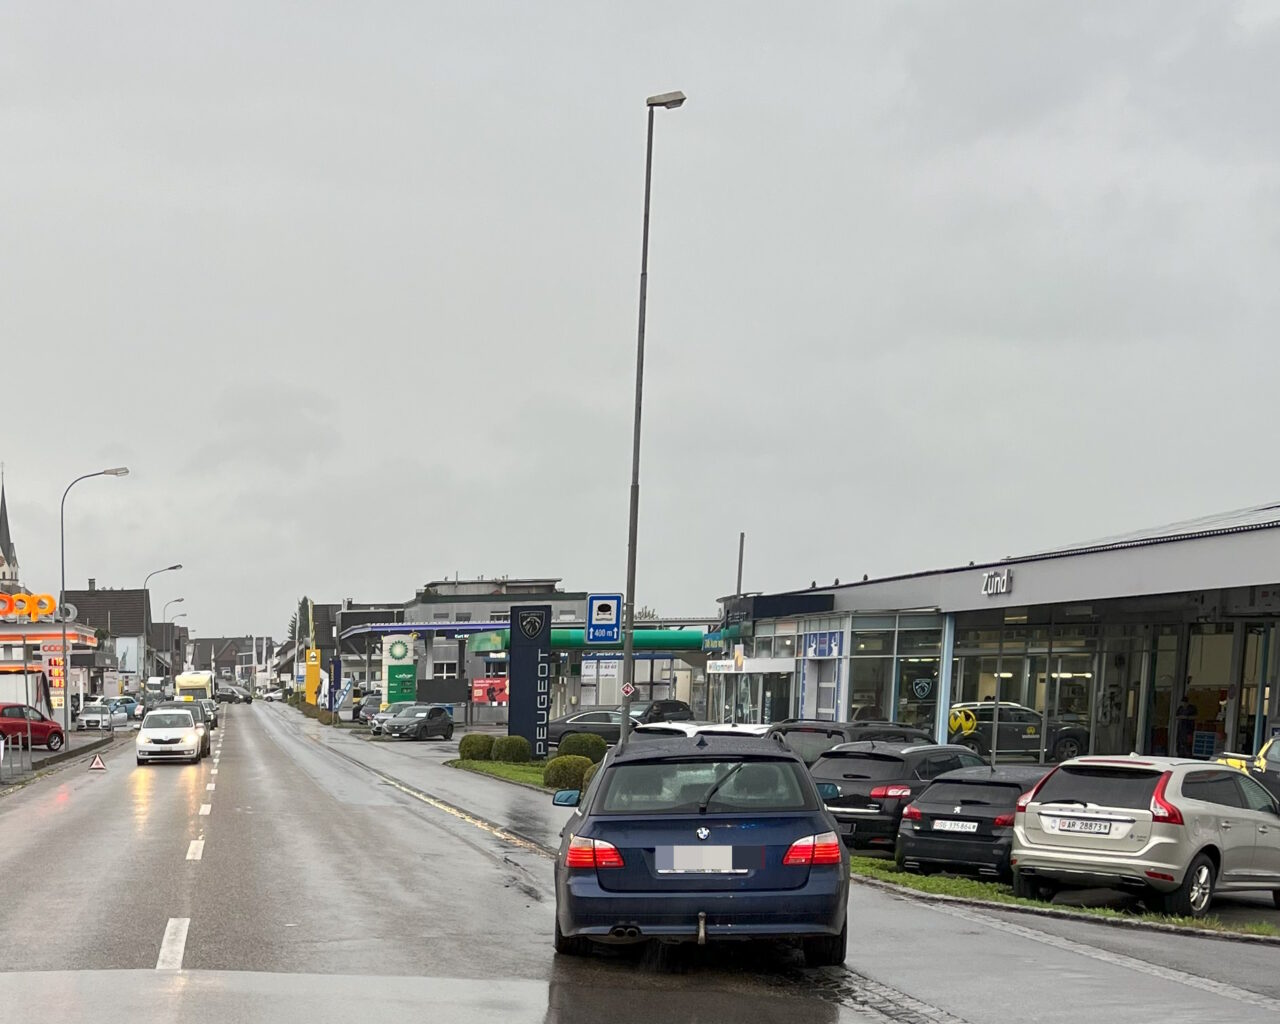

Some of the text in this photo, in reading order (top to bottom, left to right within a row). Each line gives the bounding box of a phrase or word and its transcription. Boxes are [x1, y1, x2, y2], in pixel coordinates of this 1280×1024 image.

[981, 568, 1008, 595] Zünd
[594, 628, 613, 638] 400 m
[536, 649, 549, 755] PEUGEOT
[1066, 821, 1102, 832] AR 28873
